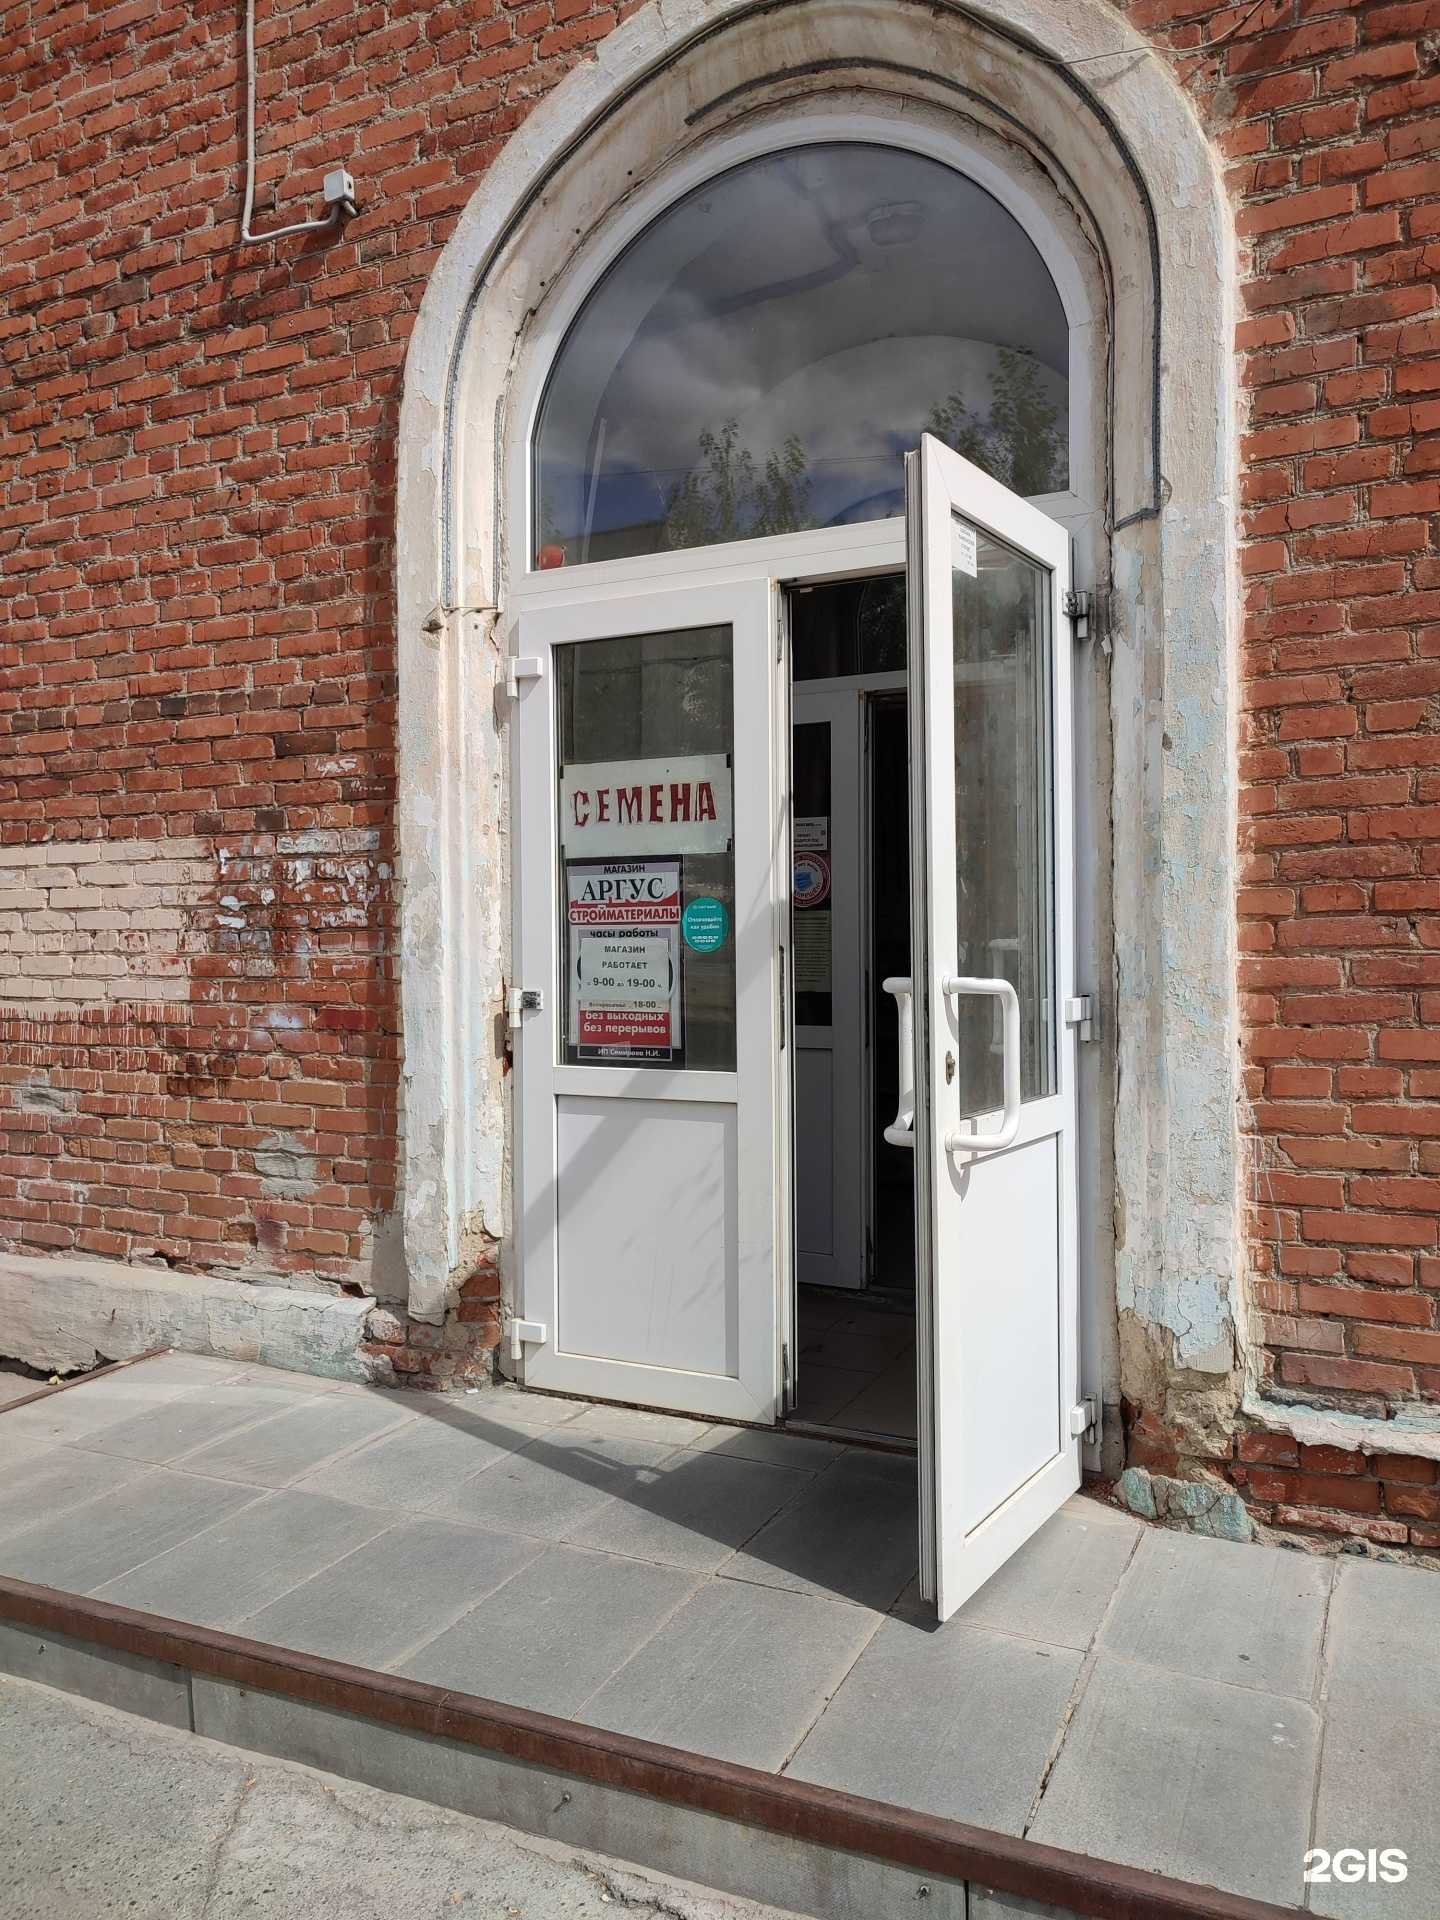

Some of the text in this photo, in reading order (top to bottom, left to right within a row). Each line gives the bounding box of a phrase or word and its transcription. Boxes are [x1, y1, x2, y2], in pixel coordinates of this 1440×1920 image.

[573, 782, 717, 827] СЕМЕНА
[603, 864, 646, 874] МАГАЗИН
[582, 877, 664, 901] АРГУС
[569, 903, 680, 922] СТРОЙМАТЕРИАЛЫ
[590, 927, 659, 938] часы работы
[604, 945, 646, 954] МАГАЗИН
[602, 961, 648, 969] РАБОТАЕТ
[593, 977, 615, 987] 9-00
[627, 978, 656, 988] 19-00
[633, 1000, 657, 1008] 18-00
[607, 1012, 665, 1022] выходных
[584, 1021, 666, 1036] без перерывов
[598, 1048, 609, 1056] ИП
